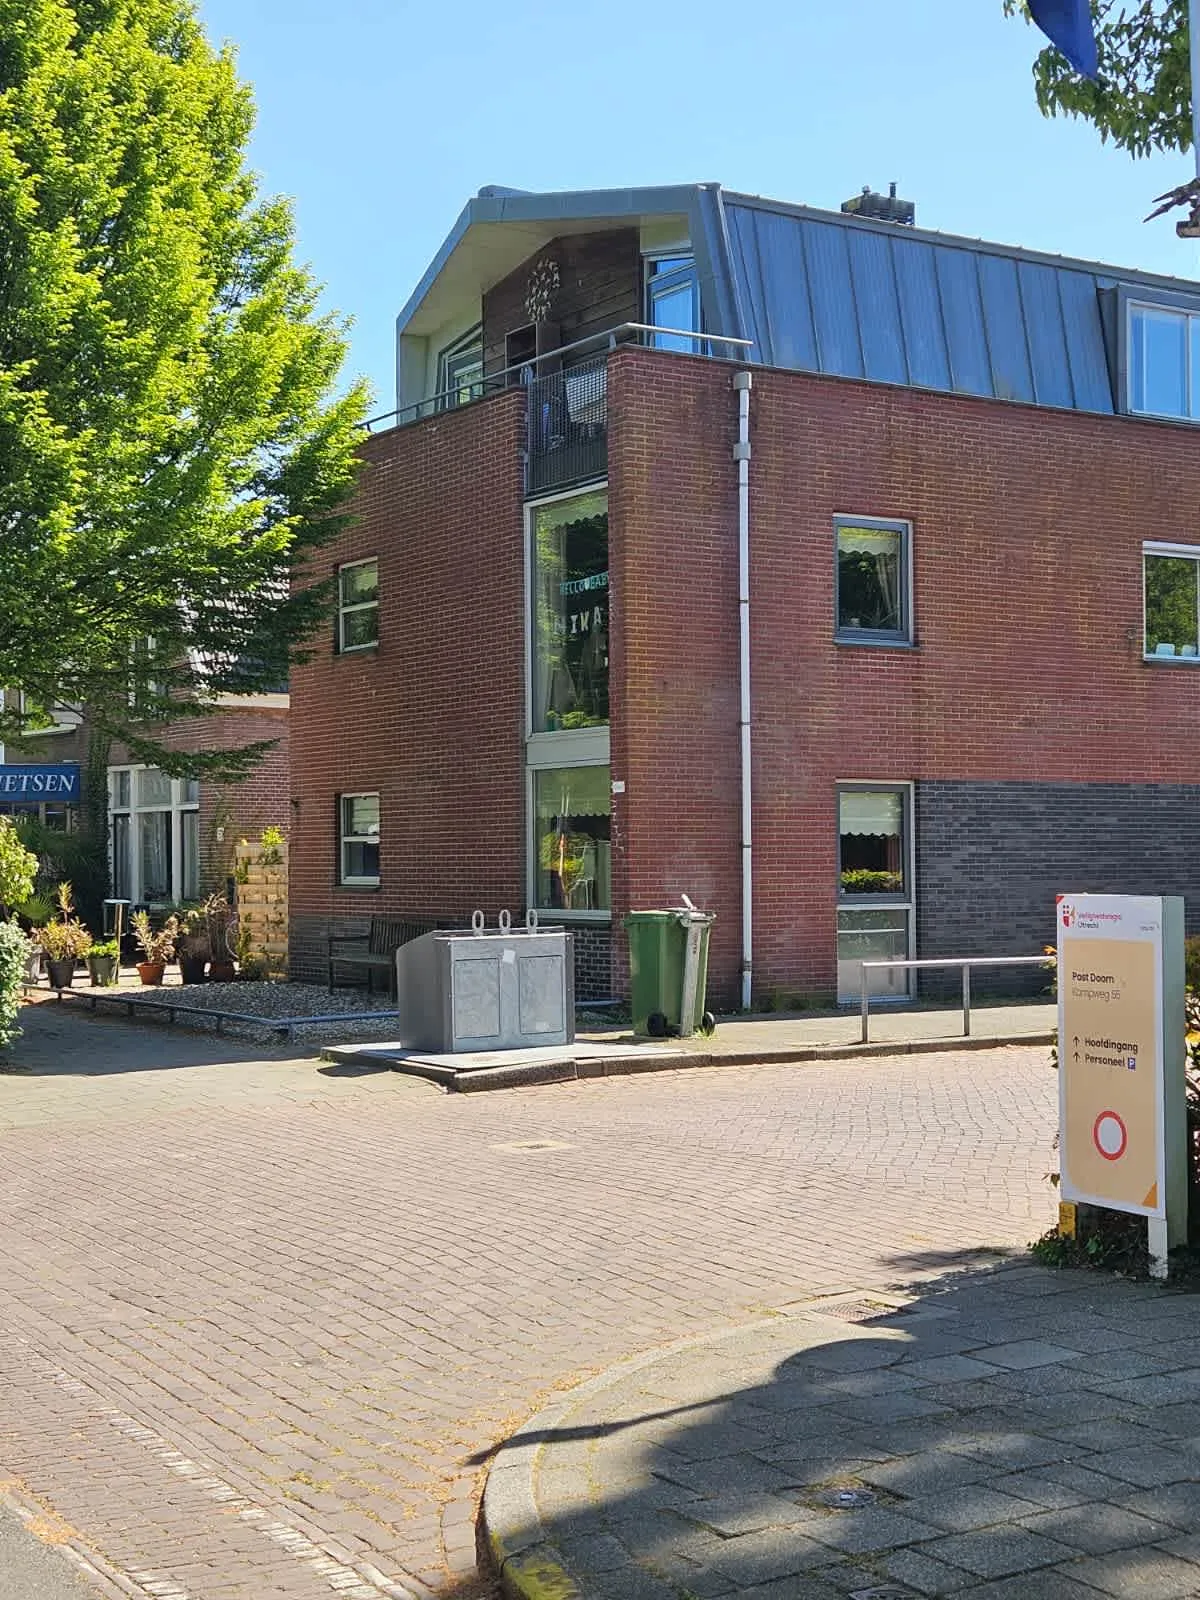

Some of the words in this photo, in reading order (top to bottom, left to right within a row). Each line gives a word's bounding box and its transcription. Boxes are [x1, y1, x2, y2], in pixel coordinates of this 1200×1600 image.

[590, 571, 608, 590] BAB
[1072, 971, 1089, 982] Post
[1090, 972, 1114, 983] Doorn
[1085, 1037, 1138, 1055] Hoofdingang
[1085, 1053, 1126, 1067] Personeel
